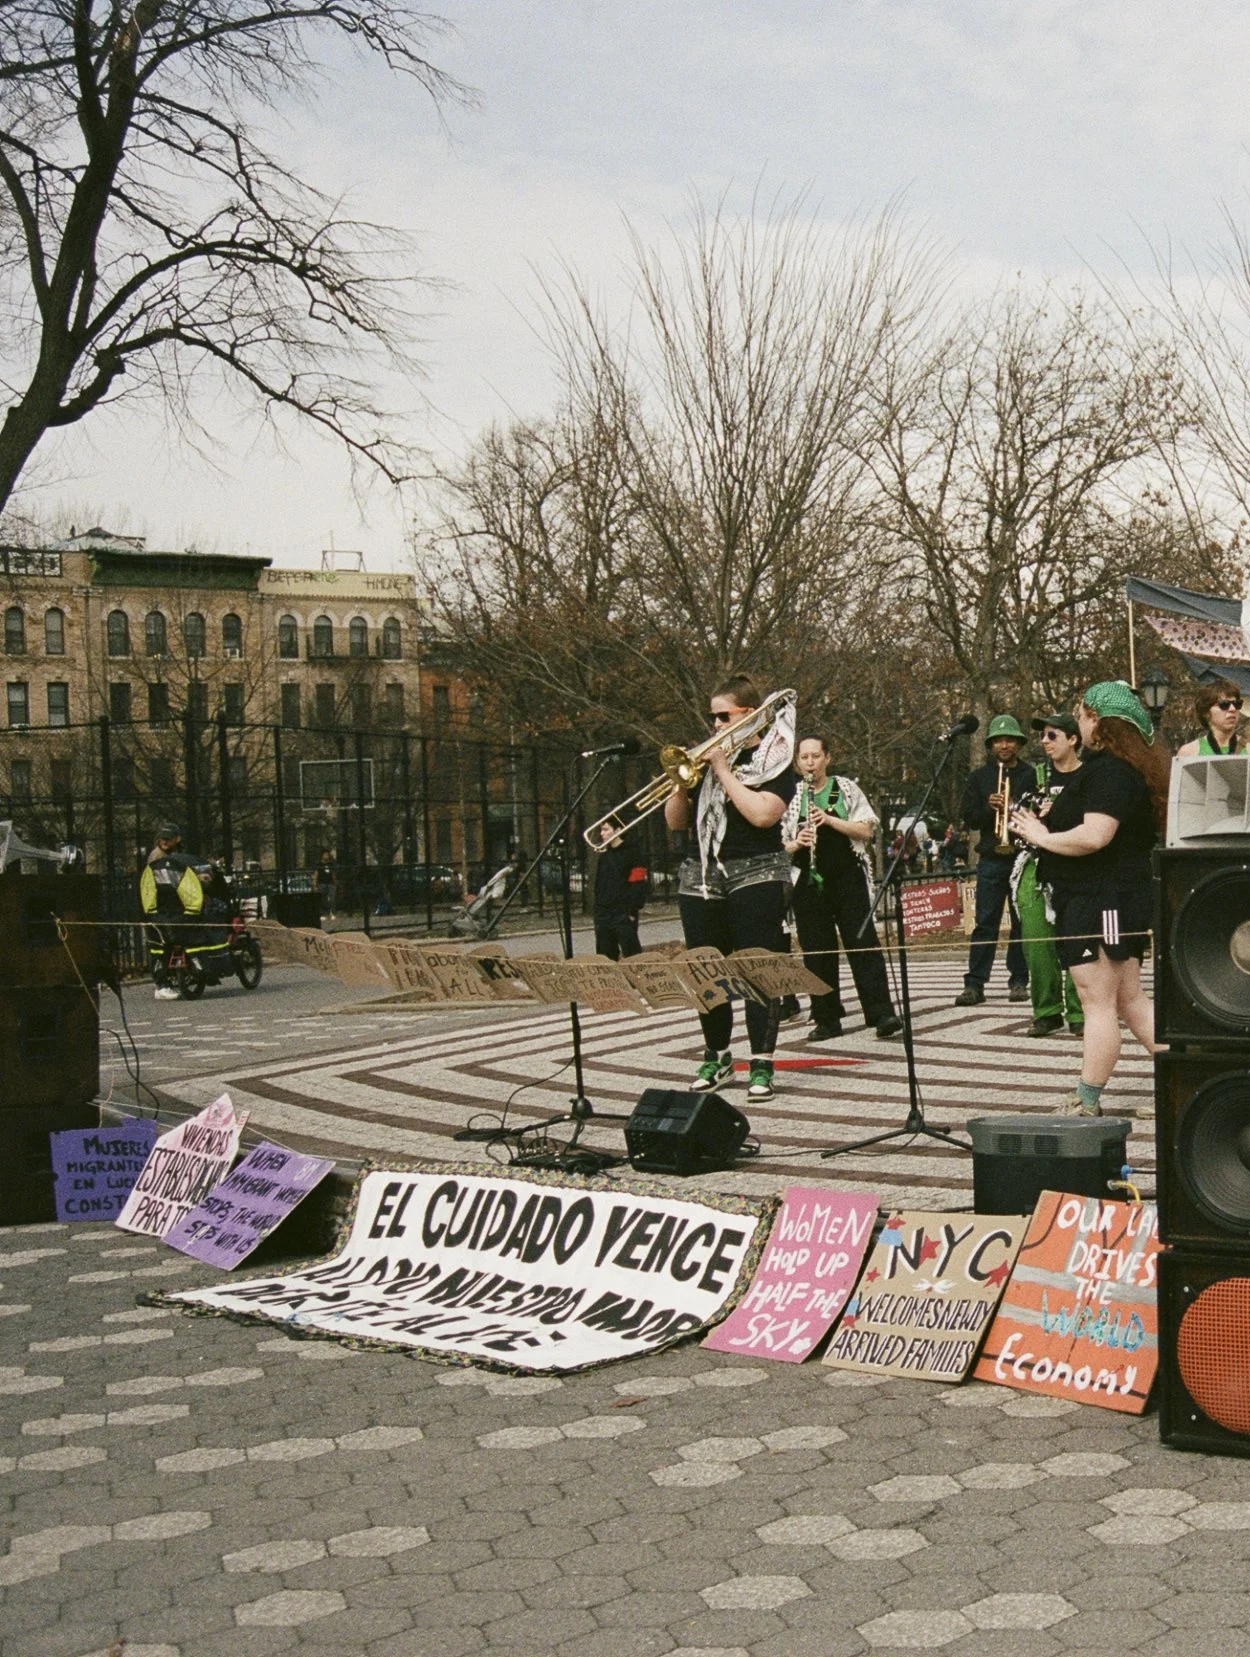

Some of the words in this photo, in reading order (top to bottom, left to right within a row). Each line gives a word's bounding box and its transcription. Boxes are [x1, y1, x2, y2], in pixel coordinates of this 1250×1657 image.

[181, 1123, 233, 1158] VIVIENDAS
[247, 1150, 291, 1172] WHEN
[74, 1178, 95, 1190] EN
[220, 1171, 280, 1199] IMMIGRANT
[64, 1194, 128, 1214] CONST
[128, 1197, 174, 1237] PARA
[231, 1206, 254, 1224] THE
[1057, 1199, 1117, 1235] OUR
[184, 1219, 222, 1240] STOPS
[213, 1231, 242, 1251] WITH
[234, 1237, 258, 1255] US
[368, 1181, 418, 1239] EL
[422, 1180, 595, 1266] CUIDADO
[594, 1205, 746, 1295] VENCE
[883, 1221, 1013, 1283] NYC
[764, 1246, 811, 1276] HOLD
[815, 1251, 850, 1278] UP
[1068, 1240, 1159, 1286] DRIVES
[290, 1256, 366, 1285] AL
[413, 1267, 588, 1326] NUESTRO
[742, 1280, 811, 1313] HALF
[804, 1288, 847, 1320] THE
[1074, 1276, 1118, 1305] THE
[857, 1291, 941, 1332] WELCOMES
[937, 1299, 998, 1333] NEWLY
[1041, 1287, 1144, 1352] WORLD
[824, 1329, 907, 1368] ARRIVED
[900, 1337, 977, 1376] FAMILIES
[994, 1332, 1138, 1396] Economy
